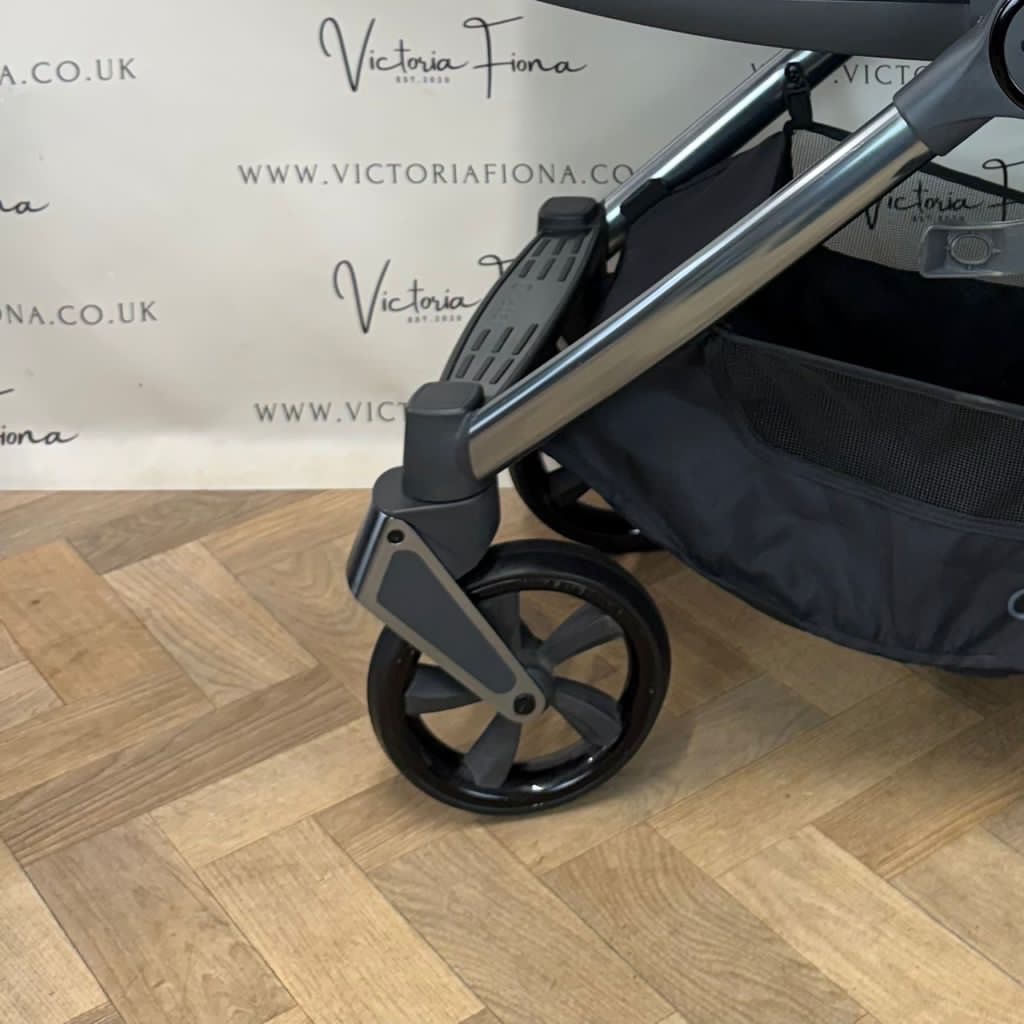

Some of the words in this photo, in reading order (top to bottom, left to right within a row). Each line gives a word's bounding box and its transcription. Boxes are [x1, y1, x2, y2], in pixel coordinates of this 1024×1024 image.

[319, 17, 469, 93] Victoria
[463, 16, 588, 99] Fiona
[332, 259, 479, 334] Victoria
